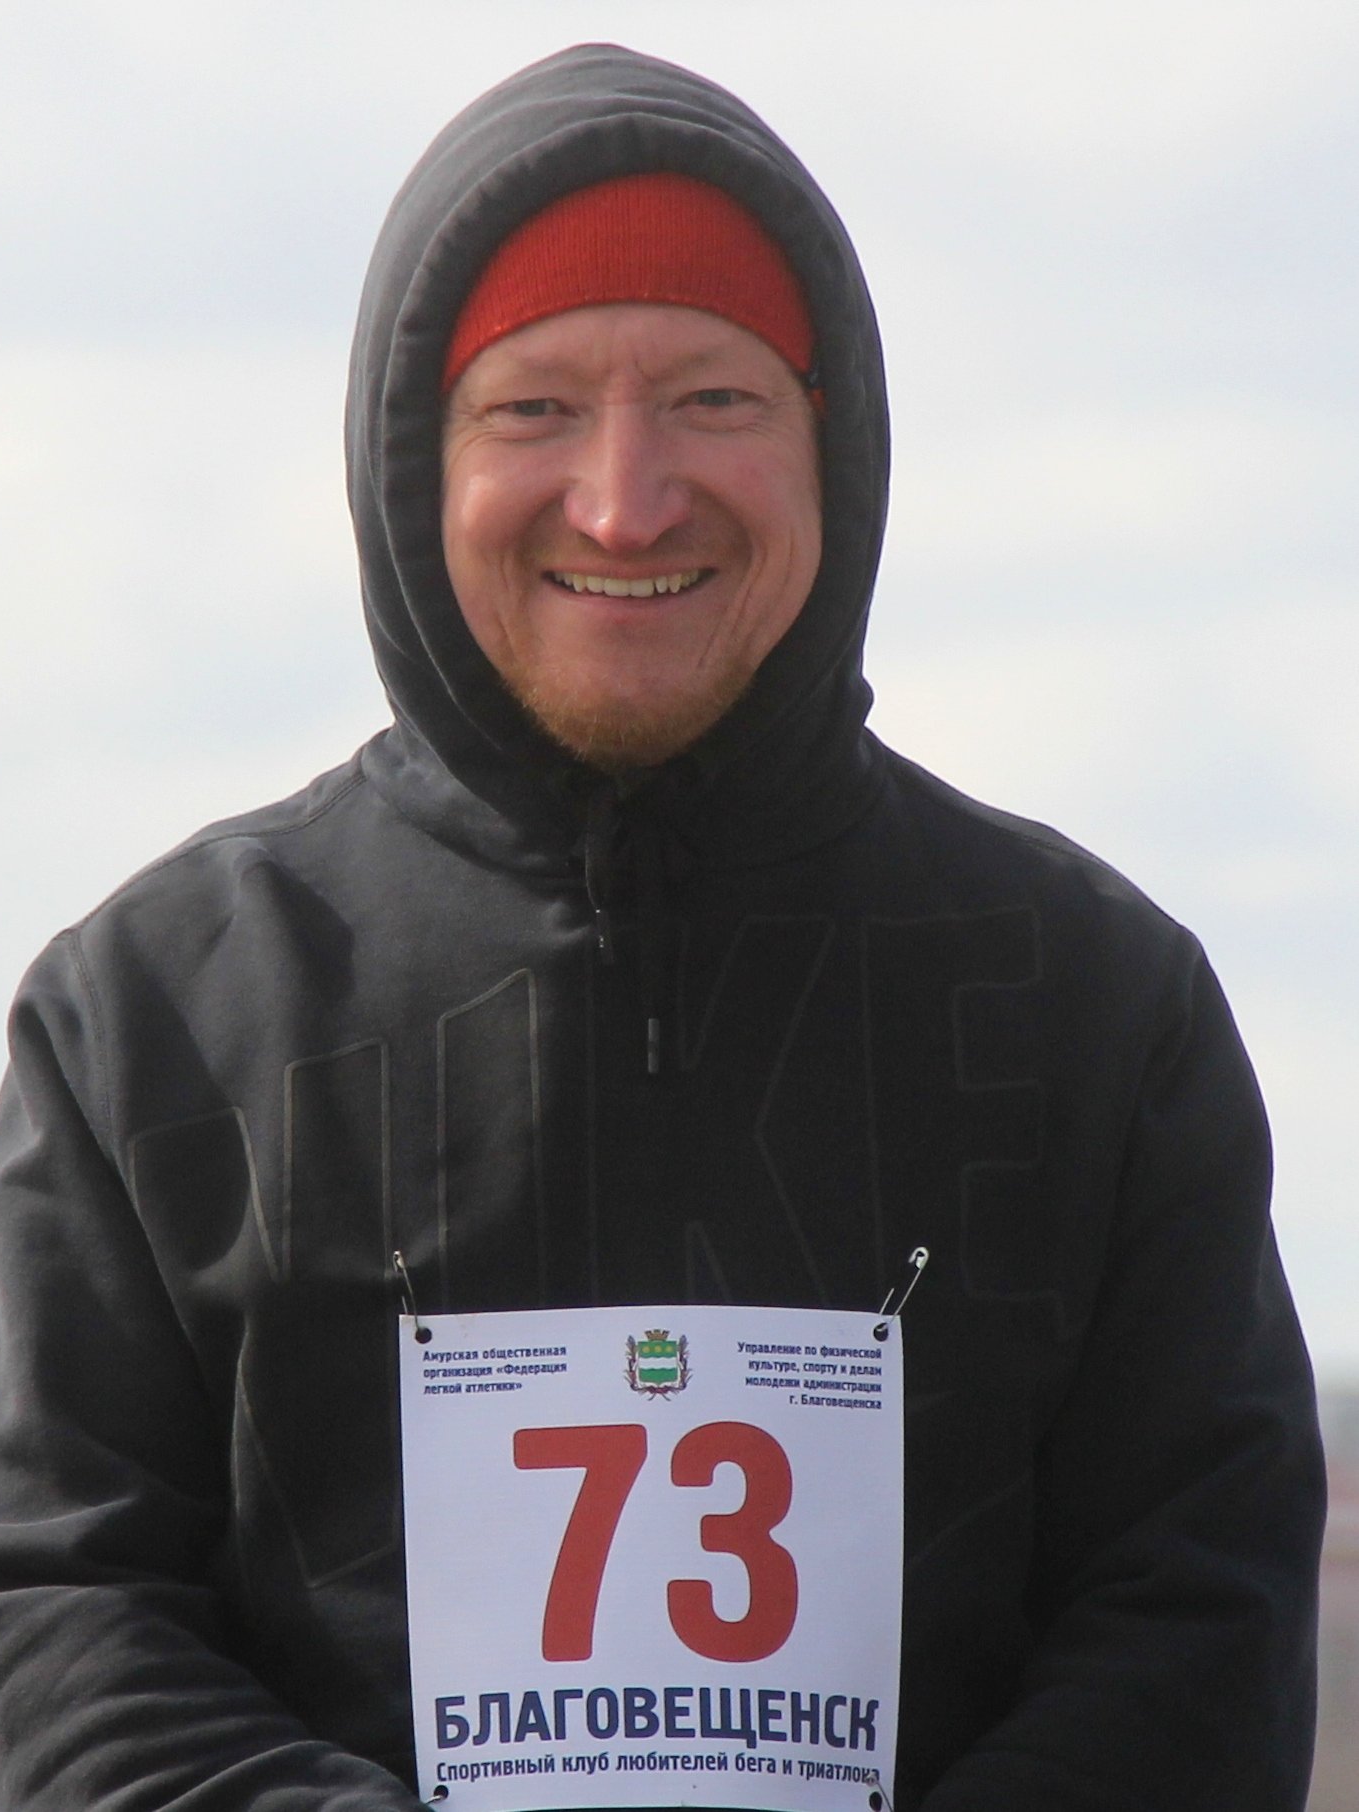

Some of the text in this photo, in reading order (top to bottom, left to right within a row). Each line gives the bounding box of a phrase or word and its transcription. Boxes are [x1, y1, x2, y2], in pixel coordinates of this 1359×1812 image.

[422, 1346, 567, 1363] Амурская общественная
[737, 1341, 882, 1360] Управление по физической
[422, 1363, 567, 1380] организация «Федерация
[748, 1360, 882, 1377] культуре, спорту и делам
[423, 1381, 522, 1395] легкой атлетики»
[745, 1377, 882, 1394] молодежи администрации
[789, 1394, 882, 1410] г. Благовещенска
[513, 1421, 798, 1663] 73
[434, 1686, 880, 1752] БЛАГОВЕЩЕНСК
[436, 1755, 555, 1782] Спортивный
[562, 1751, 609, 1775] клуб
[615, 1752, 729, 1772] любителей
[735, 1752, 776, 1774] бега
[782, 1758, 792, 1776] и
